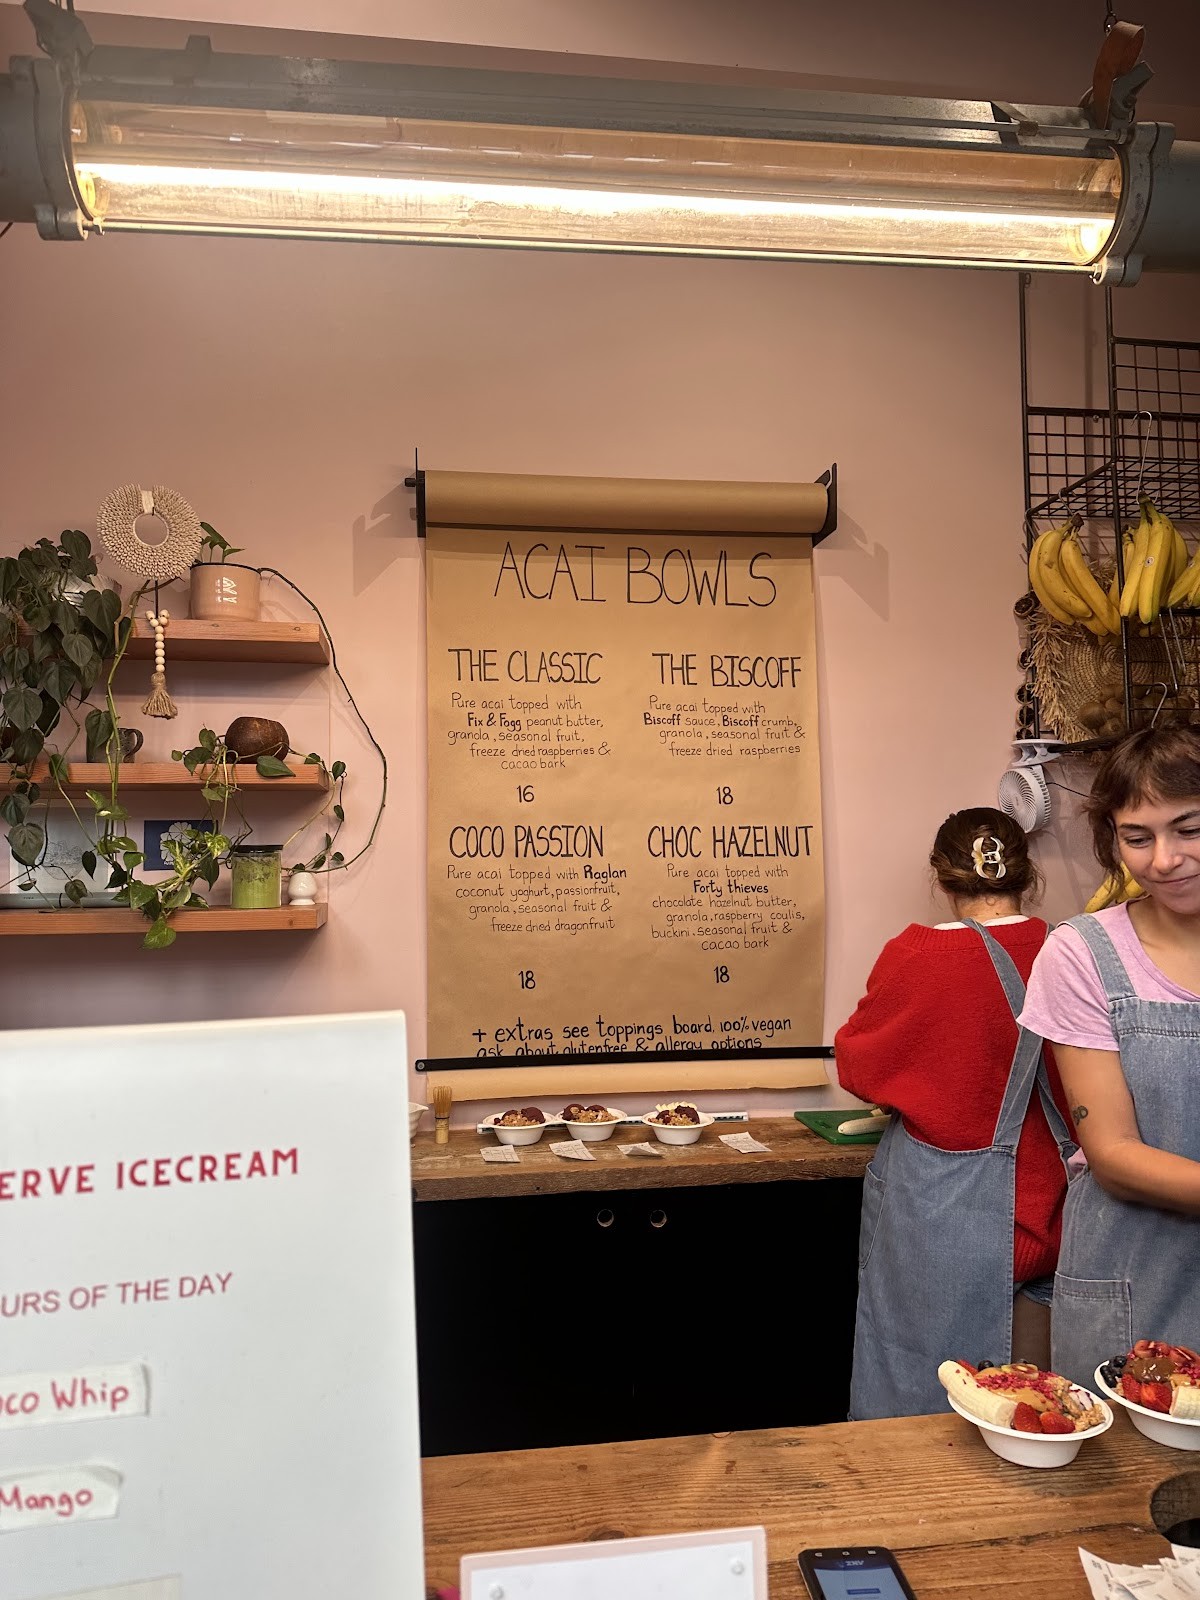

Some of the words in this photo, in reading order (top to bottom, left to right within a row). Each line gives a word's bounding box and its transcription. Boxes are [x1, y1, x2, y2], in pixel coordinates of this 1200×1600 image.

[495, 541, 606, 602] ACAI
[626, 546, 777, 607] BOWLS
[448, 649, 499, 682] THE
[507, 650, 603, 684] CLASSIC
[652, 653, 698, 685] THE
[711, 654, 801, 688] BISCOFF
[451, 692, 476, 709] Pure
[481, 699, 504, 709] acai
[509, 694, 549, 714] topped
[556, 695, 582, 709] with
[649, 695, 672, 711] Pure
[676, 702, 698, 712] acai
[702, 698, 738, 717] topped
[741, 701, 766, 714] with
[468, 712, 484, 727] Fix
[486, 712, 497, 727] &
[499, 712, 522, 732] Fogg
[526, 715, 563, 730] peanut
[566, 714, 604, 728] butter,
[643, 712, 681, 726] Biscoff
[685, 717, 721, 727] sauce,
[722, 715, 760, 727] Biscoff
[556, 729, 585, 742] fruit,
[765, 727, 790, 740] fruit
[793, 726, 806, 739] &
[469, 743, 506, 757] freeze
[511, 744, 535, 757] dried
[537, 746, 595, 759] raspberries
[598, 742, 611, 756] &
[669, 742, 702, 757] freeze
[706, 742, 733, 756] dried
[739, 745, 801, 759] raspberries
[501, 760, 537, 770] cacao
[540, 757, 566, 769] bark
[516, 785, 535, 803] 16
[716, 787, 734, 805] 18
[449, 826, 505, 858] COCO
[514, 825, 604, 859] PASSION
[647, 826, 702, 858] CHOC
[711, 825, 813, 858] HAZELNUT
[447, 864, 472, 880] Pure
[477, 868, 502, 880] acai
[509, 864, 551, 884] topped
[556, 867, 579, 880] with
[583, 863, 627, 884] Raglan
[667, 863, 689, 878] Pure
[696, 868, 719, 878] acai
[725, 864, 760, 880] topped
[765, 864, 789, 878] with
[455, 884, 504, 898] coconut
[693, 880, 723, 898] Forty
[727, 879, 769, 894] thieves
[573, 900, 597, 912] fruit
[600, 898, 613, 912] &
[652, 895, 703, 908] chocolate
[709, 895, 752, 908] hazelnut
[756, 895, 797, 908] butter,
[770, 910, 805, 921] coulis,
[490, 917, 523, 932] freeze
[525, 919, 551, 933] dried
[554, 916, 615, 935] dragonfruit
[751, 921, 778, 934] fruit
[782, 921, 793, 934] &
[701, 939, 740, 950] cacao
[743, 936, 769, 949] bark
[518, 971, 536, 989] 18
[713, 965, 730, 983] 18
[472, 1029, 487, 1042] +
[494, 1017, 553, 1042] extras
[562, 1025, 590, 1039] see
[595, 1014, 663, 1042] toppings
[720, 1016, 749, 1033] 100%
[751, 1018, 792, 1038] vegan
[476, 1044, 503, 1057] ask
[635, 1037, 649, 1052] &
[116, 1148, 298, 1190] ICECREAM
[68, 1284, 108, 1311] OF
[116, 1278, 170, 1305] THE
[178, 1271, 233, 1299] DAY
[0, 1391, 40, 1416] co
[51, 1377, 129, 1413] Whip
[0, 1485, 93, 1517] Mango
